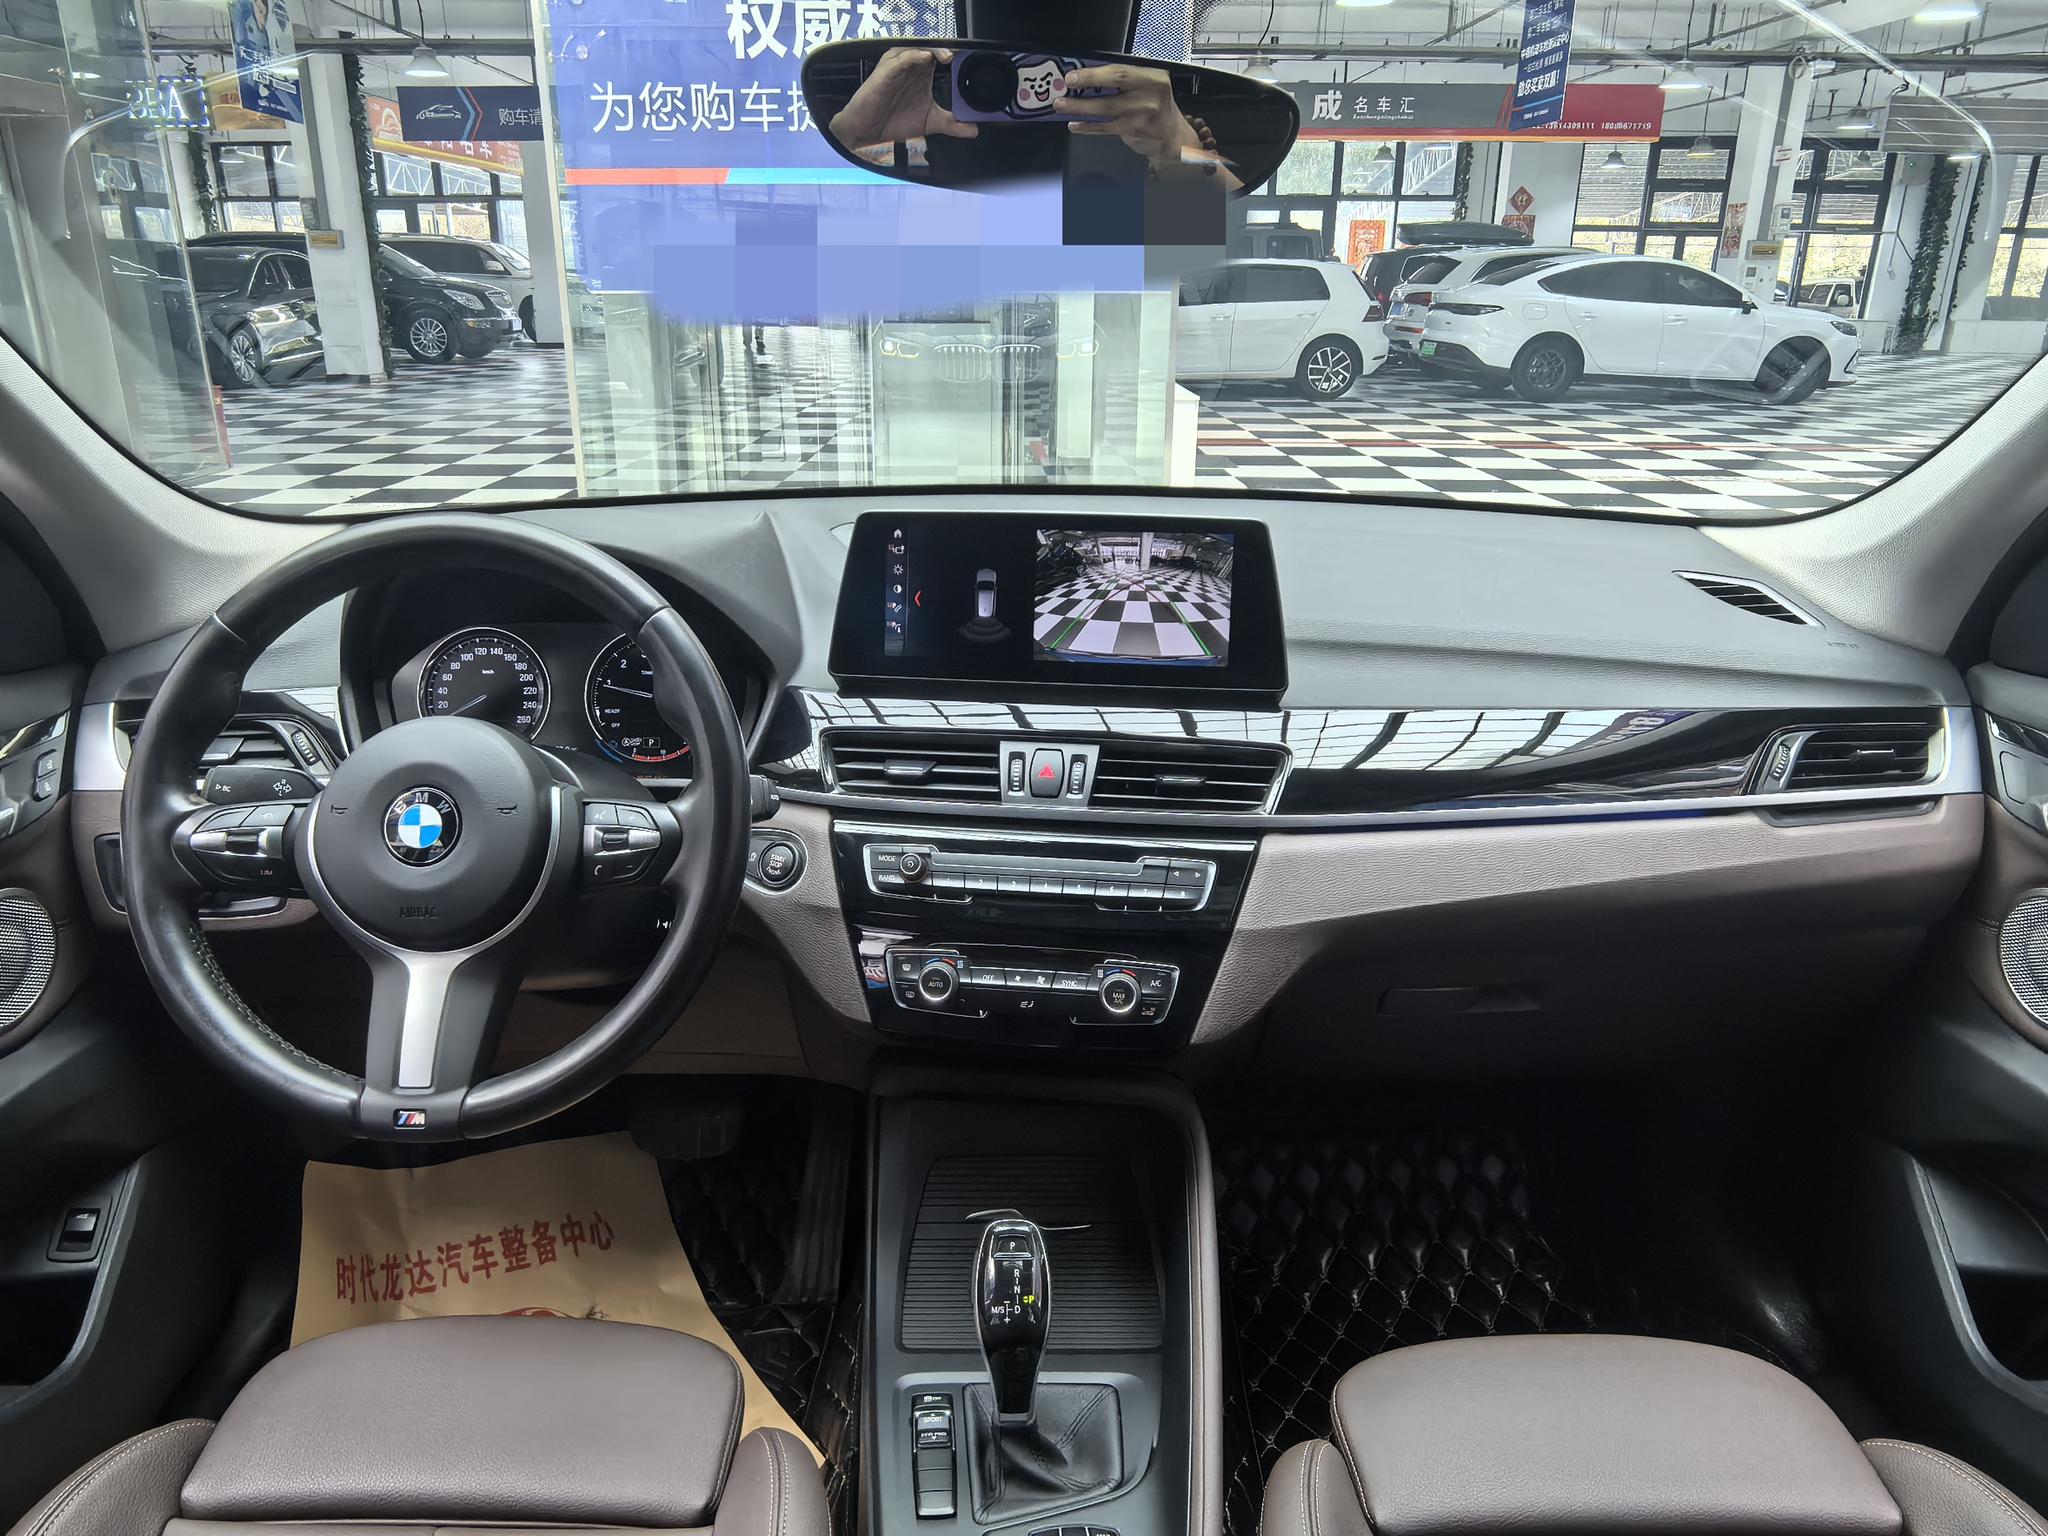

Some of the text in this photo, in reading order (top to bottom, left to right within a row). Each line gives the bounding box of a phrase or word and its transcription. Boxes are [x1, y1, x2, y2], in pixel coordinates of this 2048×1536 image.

[1353, 96, 1415, 113] 名车汇
[394, 792, 452, 815] BMW
[1009, 1241, 1015, 1250] P
[336, 1210, 614, 1304] 时代龙达汽车整备中心
[1014, 1269, 1020, 1277] R
[1014, 1305, 1020, 1314] D
